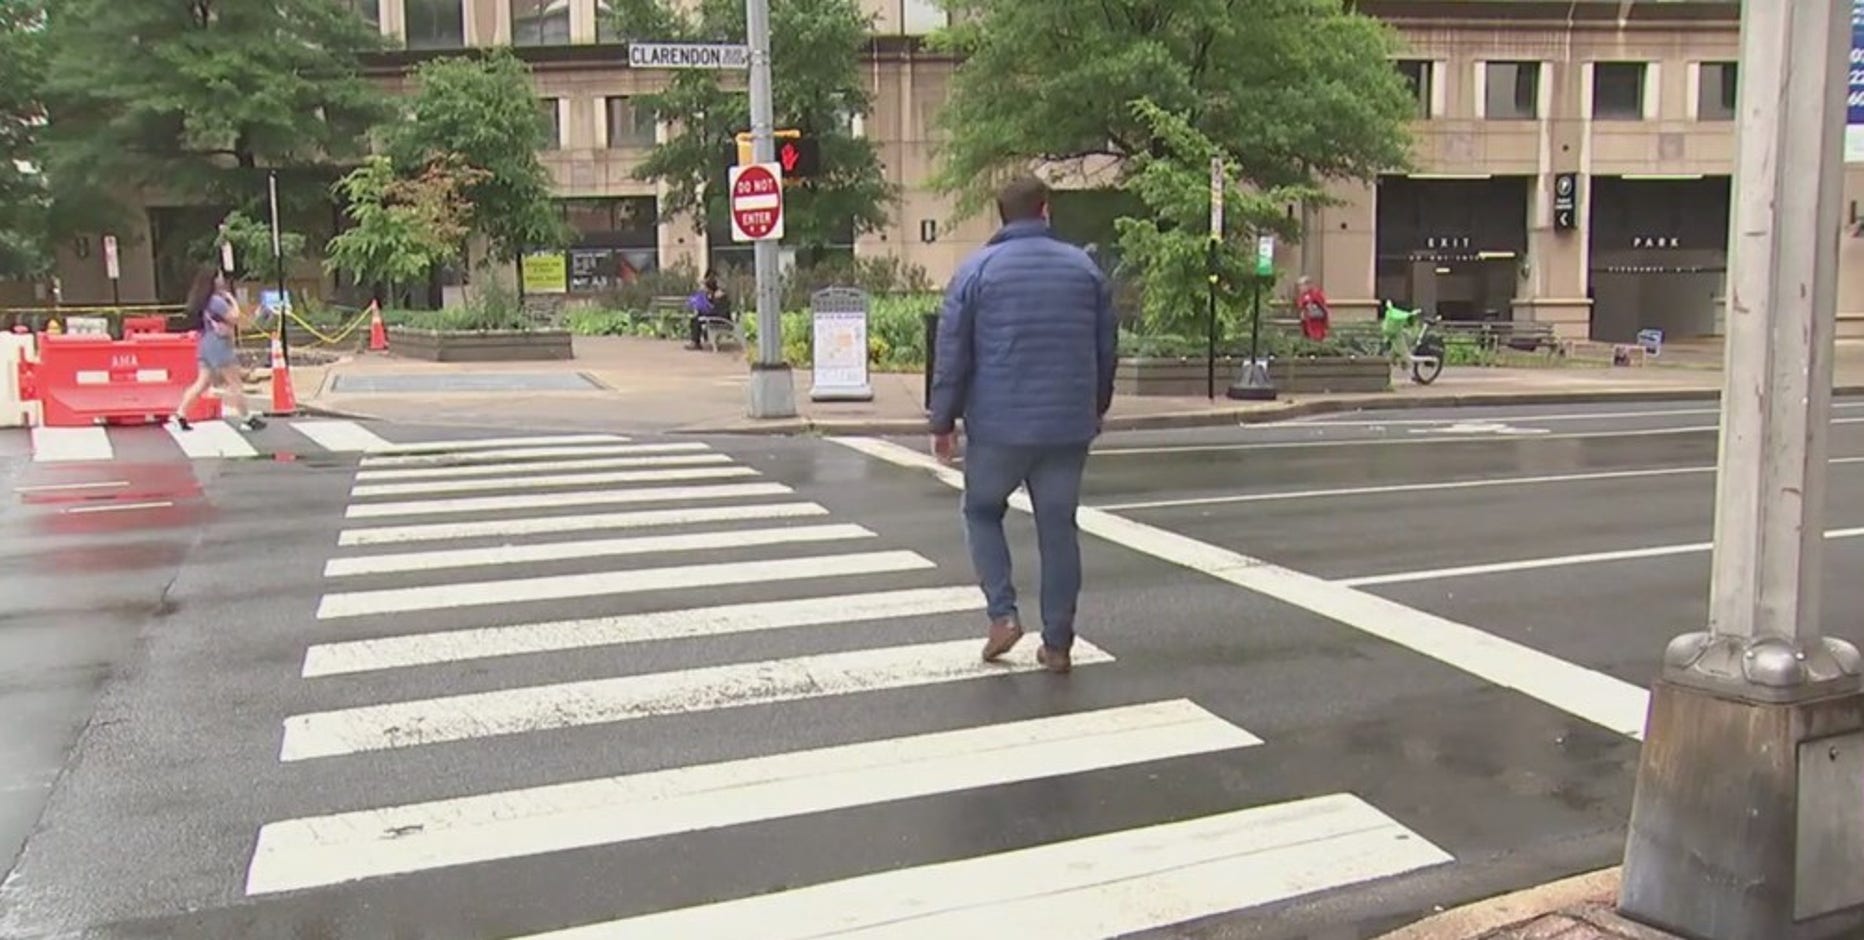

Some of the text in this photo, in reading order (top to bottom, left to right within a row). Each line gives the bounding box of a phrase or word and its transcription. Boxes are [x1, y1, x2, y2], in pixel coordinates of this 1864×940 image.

[630, 47, 720, 65] CLARENDON
[737, 178, 773, 194] DO NOT
[742, 211, 772, 226] ENTER
[1427, 237, 1469, 248] EXIT
[1633, 237, 1679, 248] PARK
